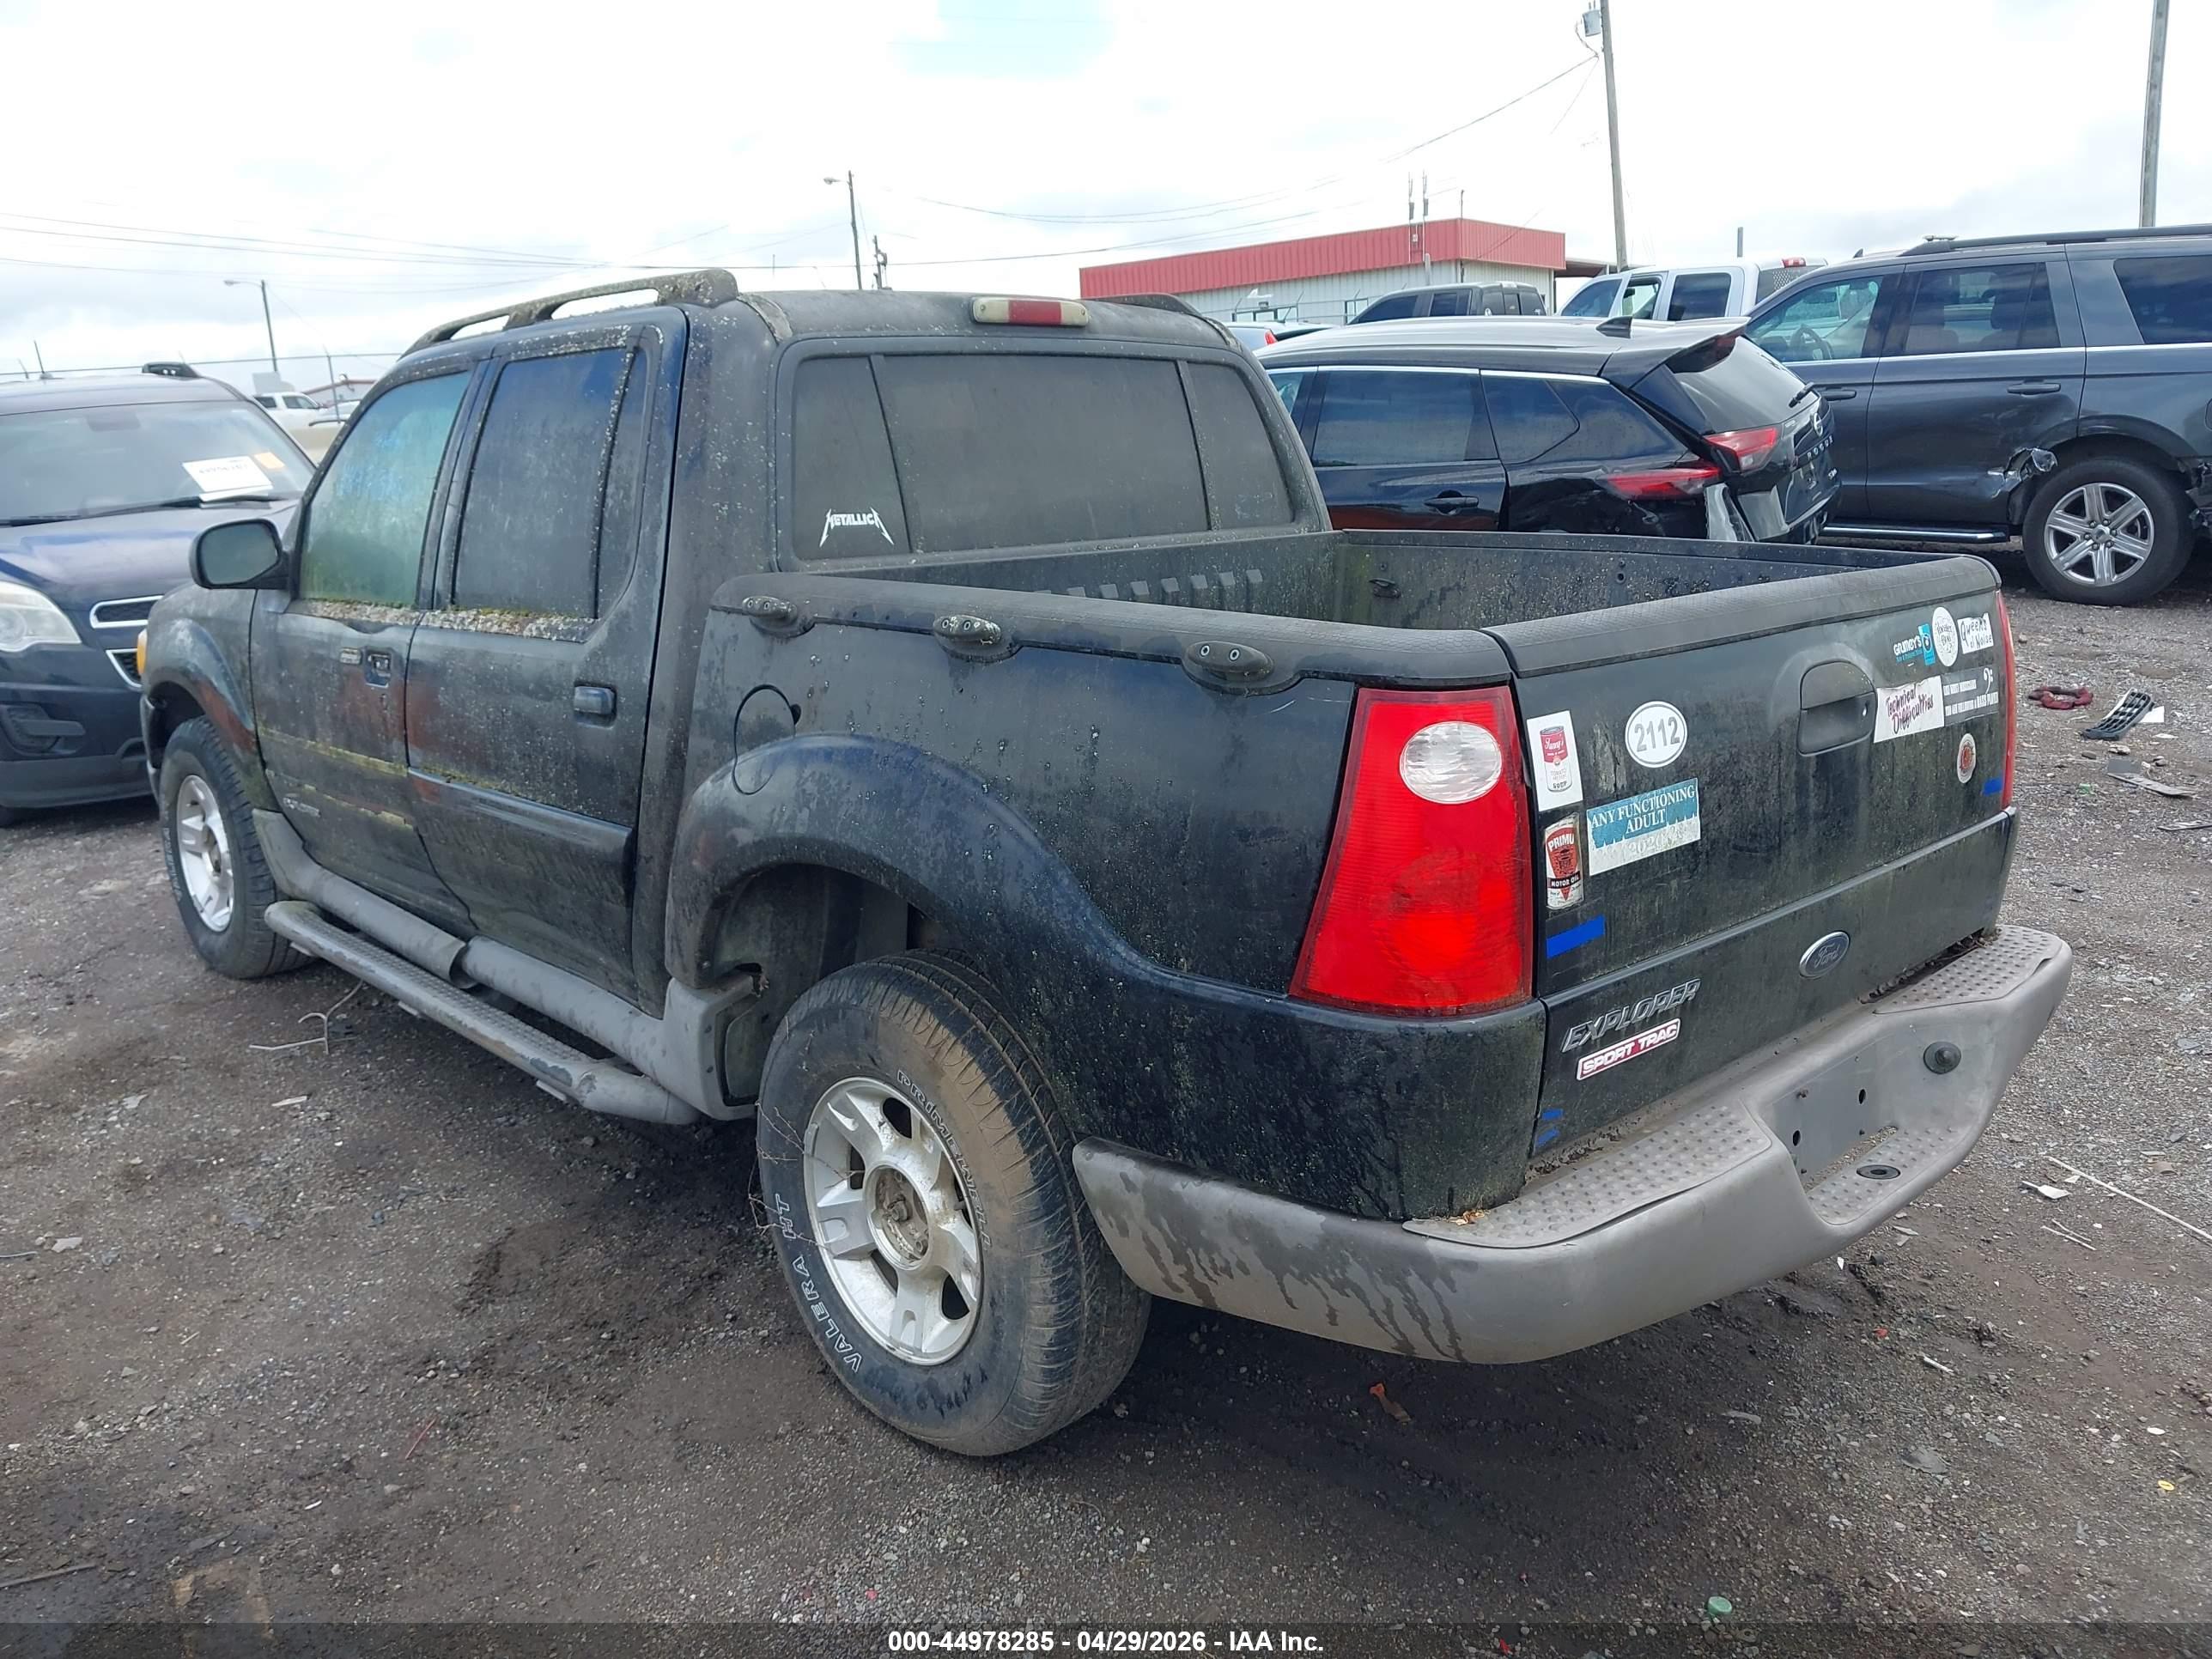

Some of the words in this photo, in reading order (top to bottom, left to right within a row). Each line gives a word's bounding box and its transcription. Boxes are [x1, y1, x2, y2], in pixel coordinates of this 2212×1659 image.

[819, 507, 895, 548] METALLICA
[1633, 716, 1681, 752] 2112
[1591, 809, 1616, 829] ANY
[1617, 784, 1695, 819] FUNCTIONING
[1625, 808, 1667, 835] ADULT
[1551, 878, 1570, 888] MOTOR
[1570, 874, 1580, 884] OIL
[1561, 978, 1702, 1053] EXPLORER
[1582, 1042, 1636, 1075] SPORT
[1638, 1023, 1678, 1050] TRAC
[775, 1193, 797, 1239] HT
[792, 1255, 864, 1373] VALERA
